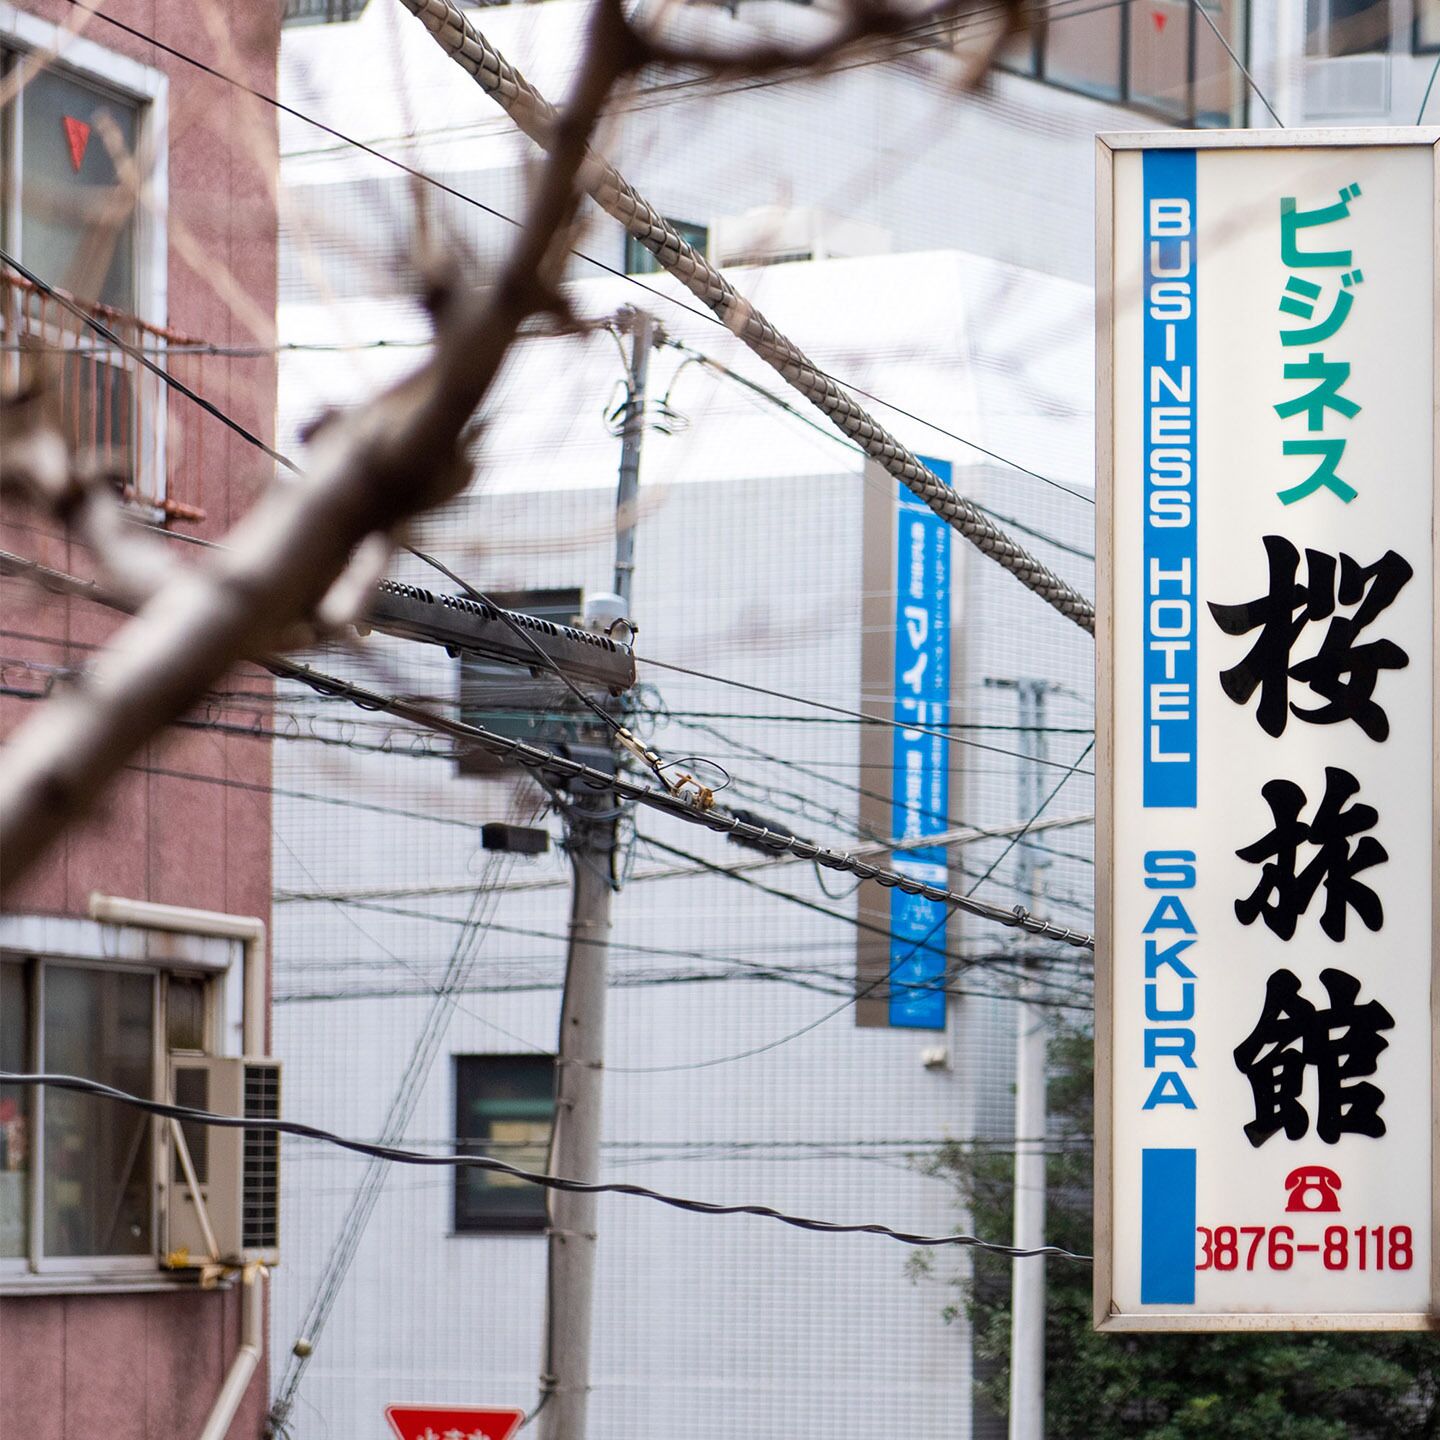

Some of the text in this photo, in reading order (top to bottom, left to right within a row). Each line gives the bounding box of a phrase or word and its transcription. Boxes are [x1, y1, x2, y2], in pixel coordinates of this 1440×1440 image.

[1142, 197, 1198, 1111] BUSINESS HOTEL SAKURA
[1206, 181, 1414, 1149] ビジネス 桜旅館
